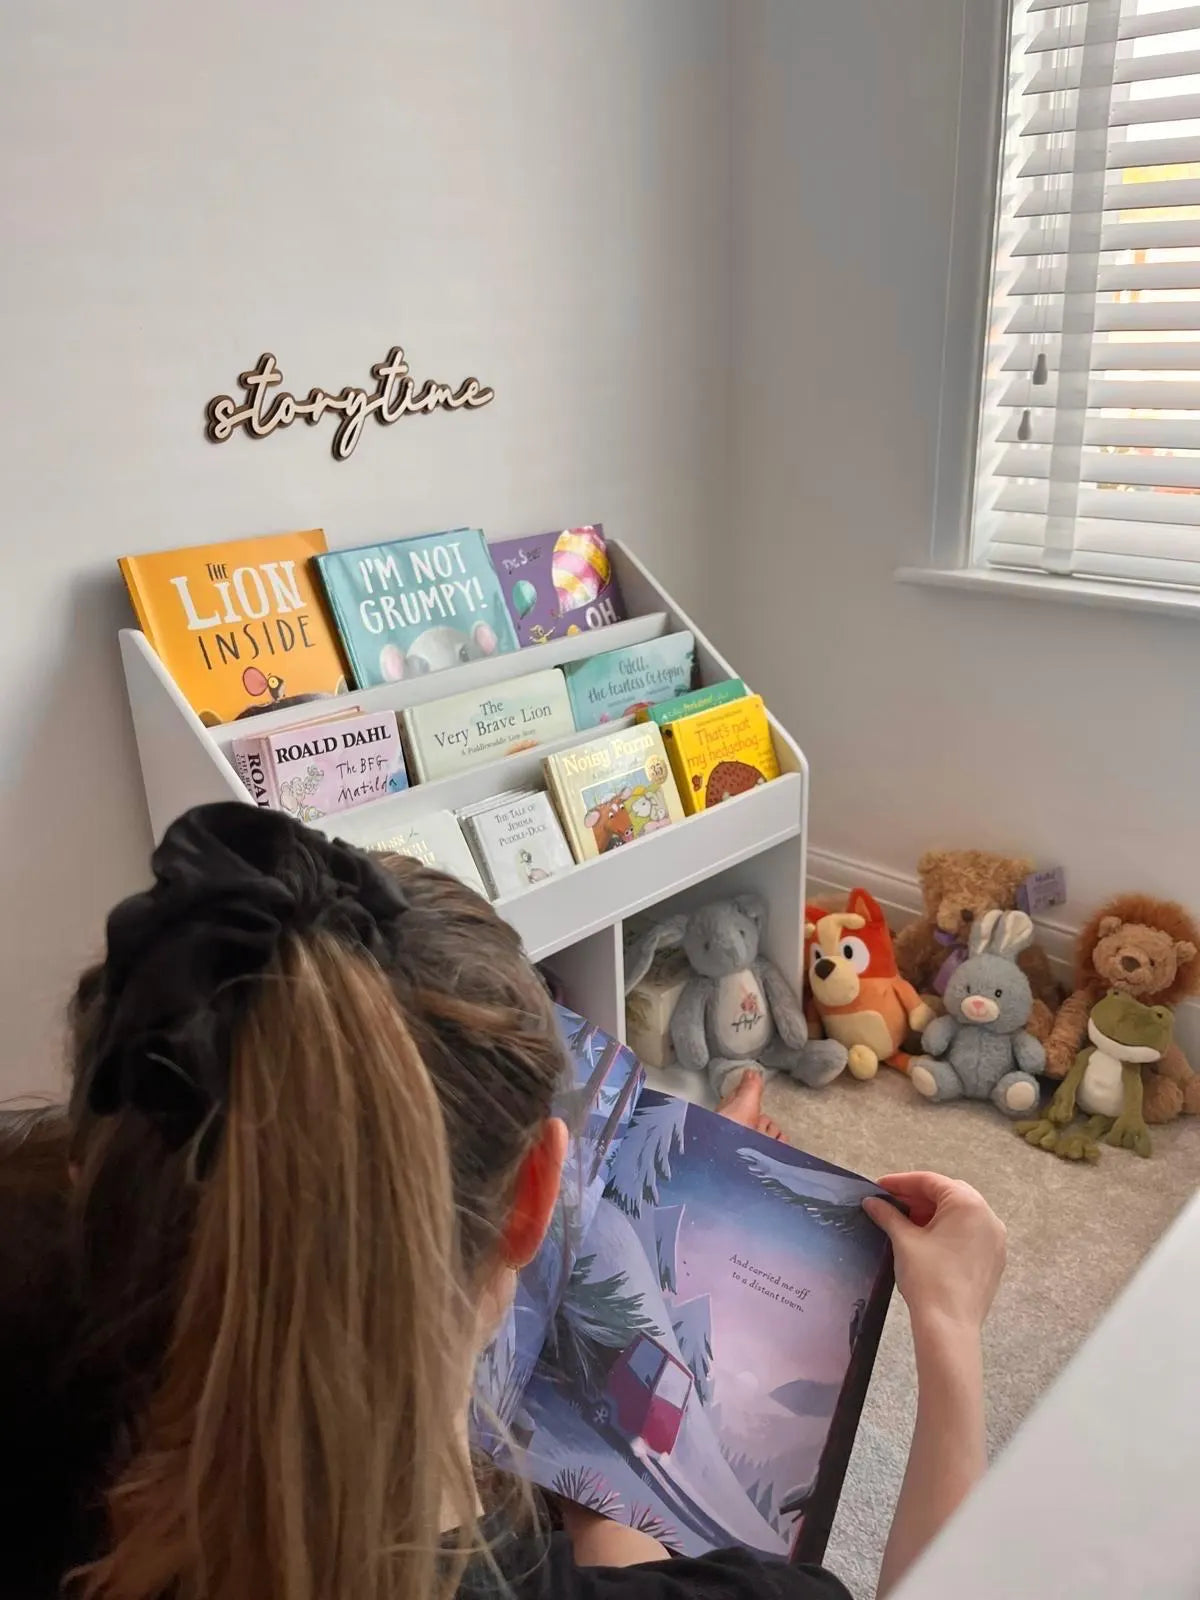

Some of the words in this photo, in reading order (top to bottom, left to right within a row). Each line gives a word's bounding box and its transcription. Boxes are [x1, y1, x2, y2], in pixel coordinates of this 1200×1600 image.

[205, 346, 495, 461] storytime
[206, 562, 229, 581] THE
[359, 555, 404, 594] I'M
[409, 542, 466, 584] NOT
[170, 560, 307, 631] LION
[360, 576, 488, 635] GRUMPY!
[198, 615, 316, 670] INSIDE
[480, 700, 504, 717] The
[588, 687, 608, 703] the
[275, 736, 338, 764] ROALD
[342, 725, 391, 749] DAHL
[434, 728, 469, 748] Very
[476, 716, 516, 737] Brave
[520, 704, 552, 723] Lion
[247, 752, 270, 807] ROA
[336, 759, 357, 778] The
[337, 775, 398, 802] Matilda
[729, 1253, 749, 1269] And
[748, 1265, 781, 1286] carried
[781, 1281, 795, 1292] me
[795, 1287, 811, 1301] off
[732, 1271, 741, 1281] to
[748, 1279, 780, 1301] distant
[780, 1296, 804, 1313] town.
